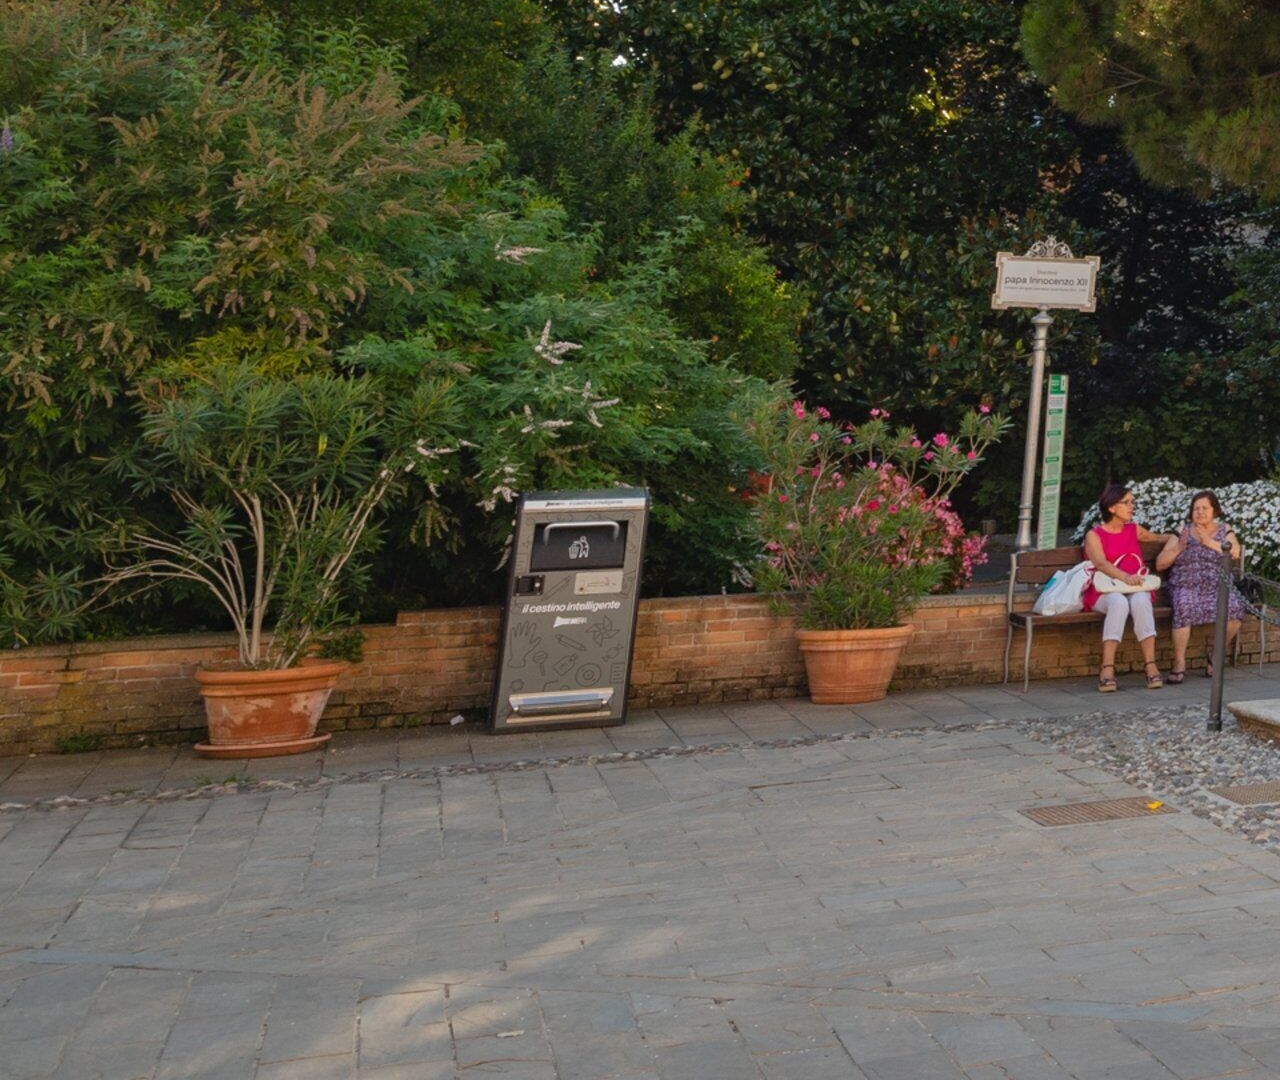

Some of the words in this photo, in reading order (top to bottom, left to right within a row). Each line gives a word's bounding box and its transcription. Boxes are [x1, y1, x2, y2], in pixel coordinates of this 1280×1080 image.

[1004, 276, 1027, 285] papa
[1029, 276, 1074, 286] Innocenzo
[522, 604, 530, 613] il
[529, 603, 566, 613] cestino
[566, 601, 621, 612] intelligente
